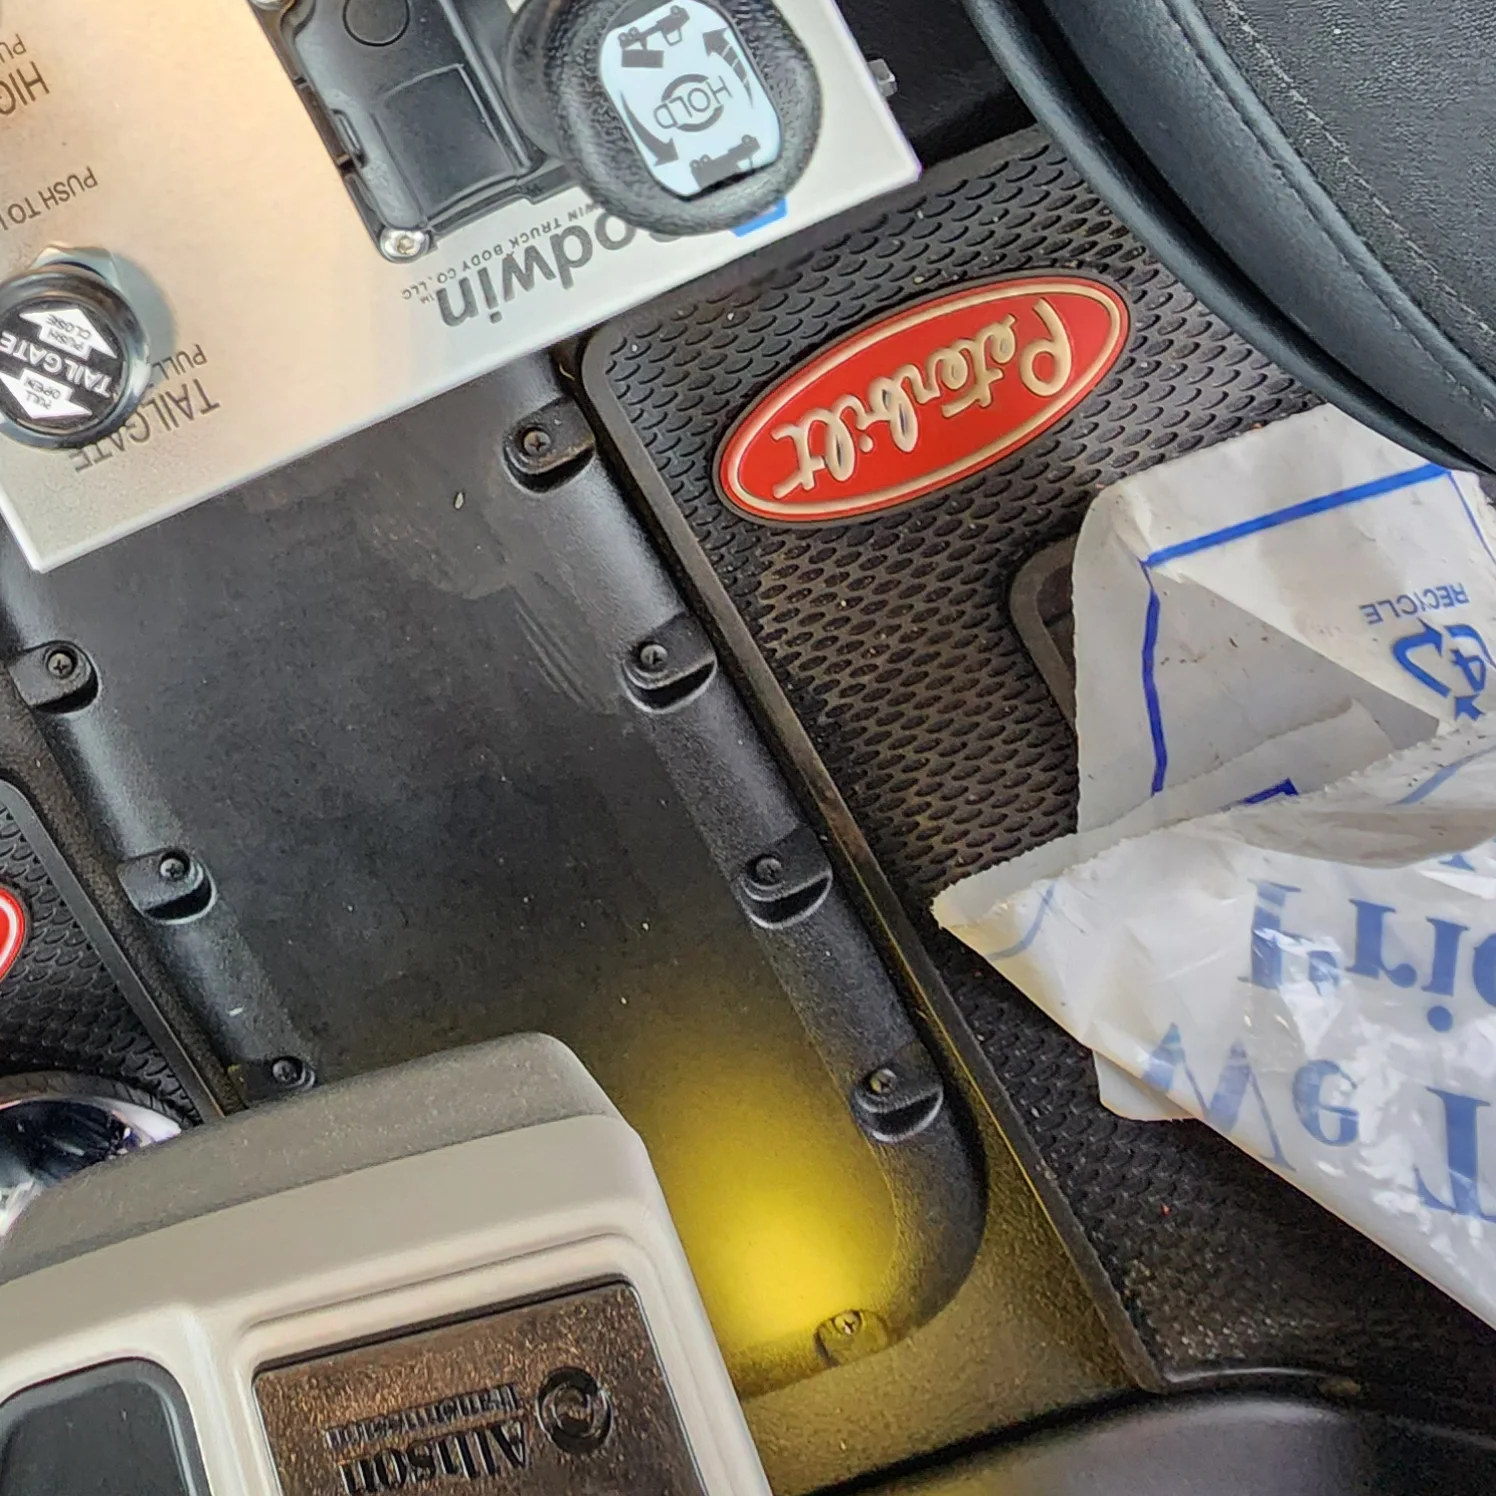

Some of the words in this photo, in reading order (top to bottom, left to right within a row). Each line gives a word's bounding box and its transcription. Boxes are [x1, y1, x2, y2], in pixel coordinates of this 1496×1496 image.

[654, 75, 732, 129] HOLD
[38, 166, 98, 210] PUSH
[7, 197, 41, 224] TO
[508, 217, 562, 249] TRUCK
[436, 211, 682, 326] odwin
[462, 243, 504, 273] BODY
[401, 282, 429, 300] LLC
[45, 314, 92, 340] CLOSE
[152, 343, 208, 380] PULL
[25, 390, 53, 410] PULL
[26, 378, 62, 400] OPEN
[772, 298, 1072, 499] Peterbilt
[68, 378, 221, 473] TAILGATE
[1359, 583, 1470, 625] RECYCLE
[338, 1416, 527, 1496] Allison
